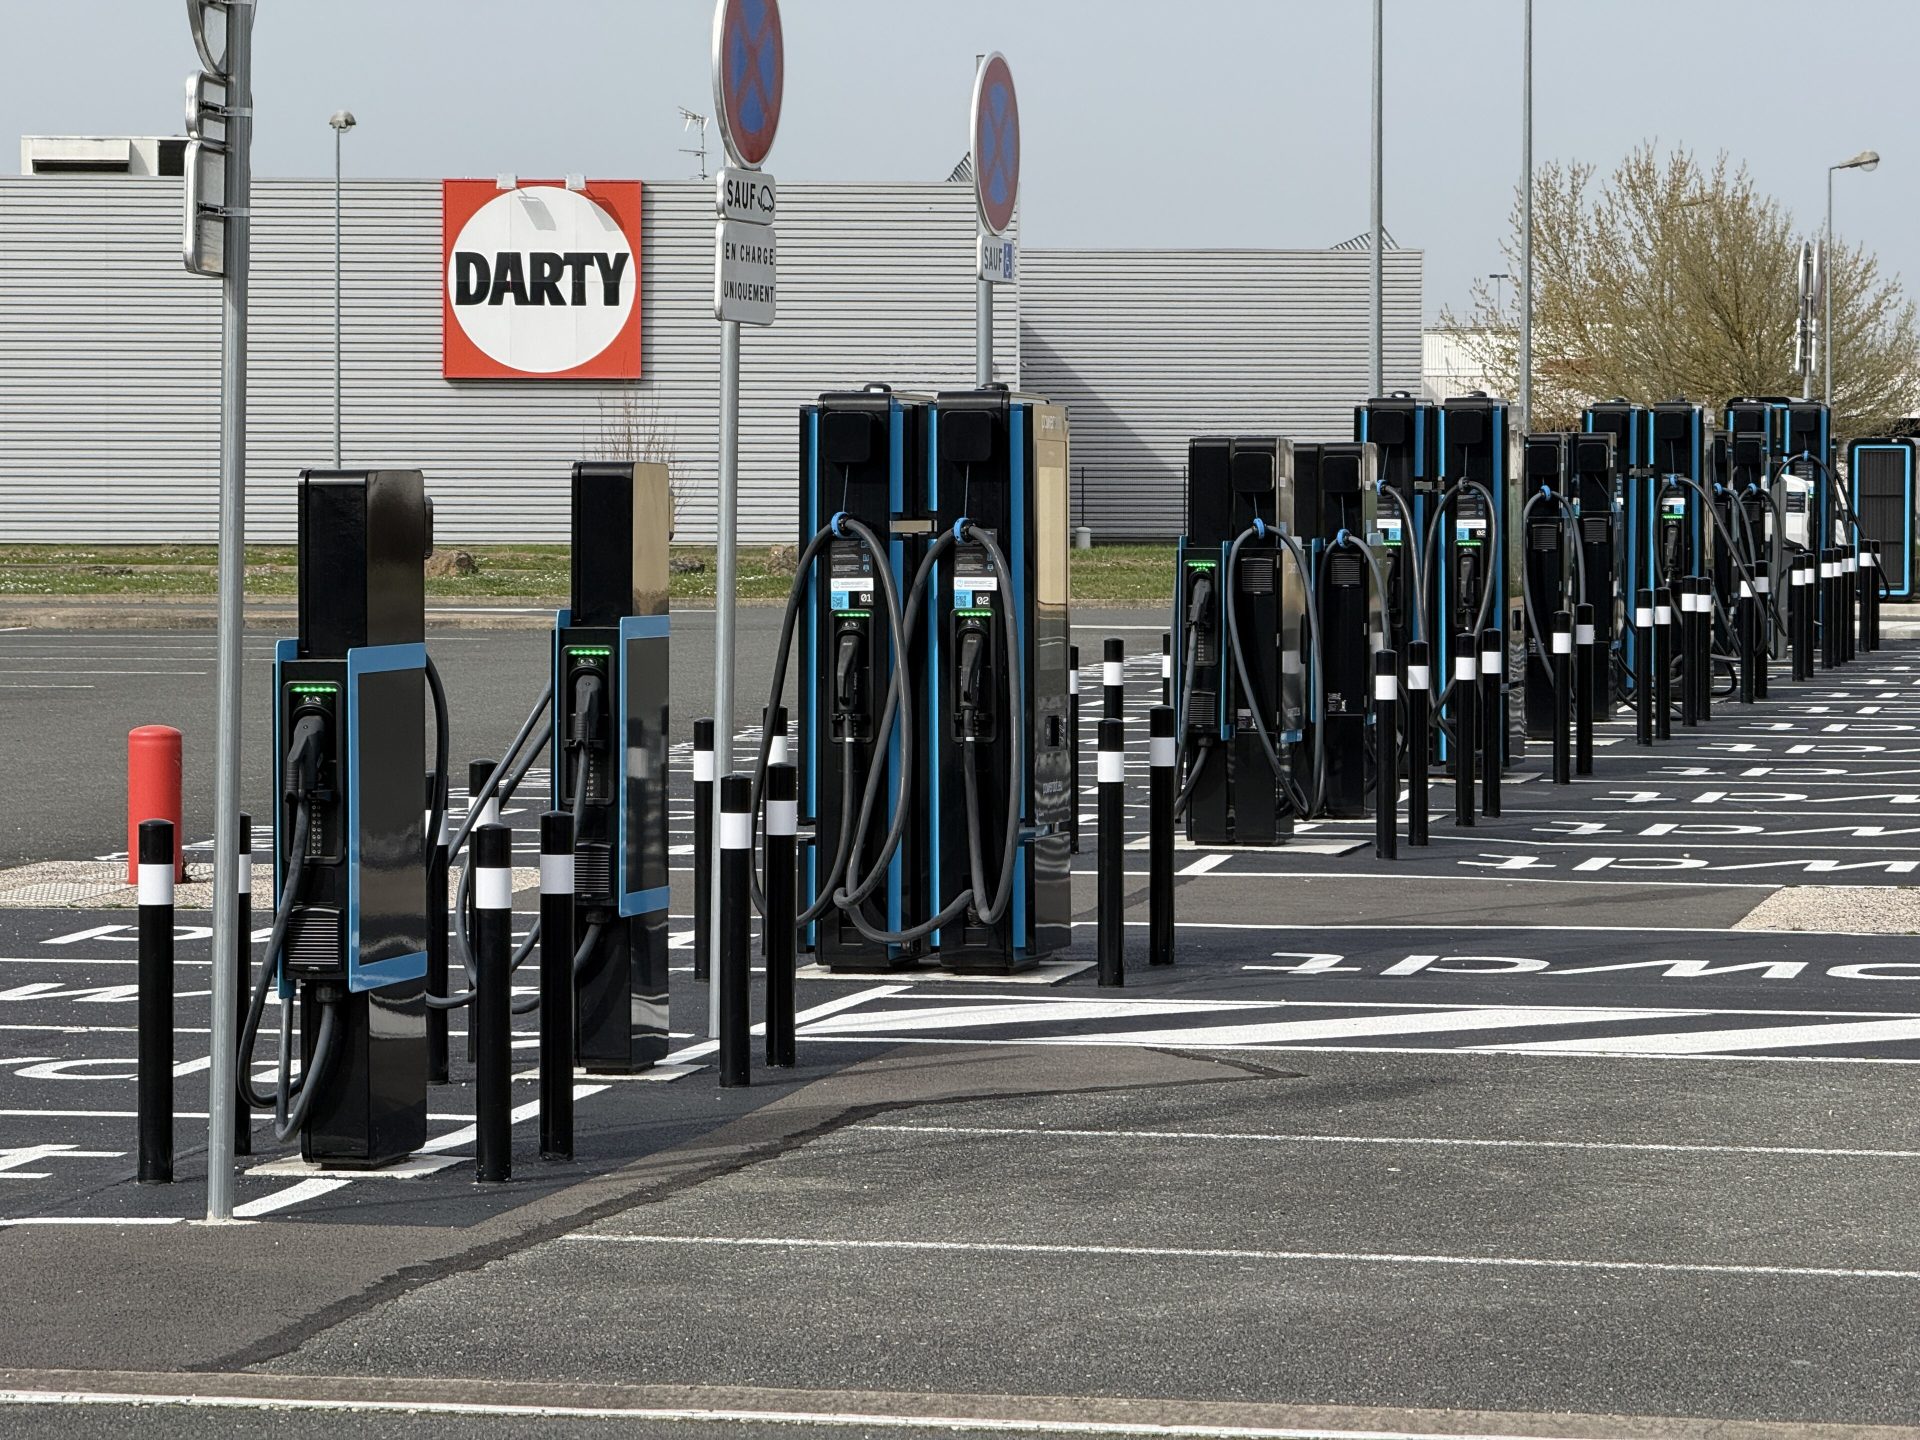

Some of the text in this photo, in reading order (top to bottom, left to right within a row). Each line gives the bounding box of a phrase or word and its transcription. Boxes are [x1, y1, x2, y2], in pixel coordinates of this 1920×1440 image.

[727, 179, 756, 210] SAUF
[725, 242, 774, 266] EN CHARGE
[984, 246, 1003, 271] SAUF
[455, 252, 630, 306] DARTY
[724, 281, 774, 303] UNIQUEMENT
[860, 593, 872, 603] 01
[976, 596, 989, 605] 02
